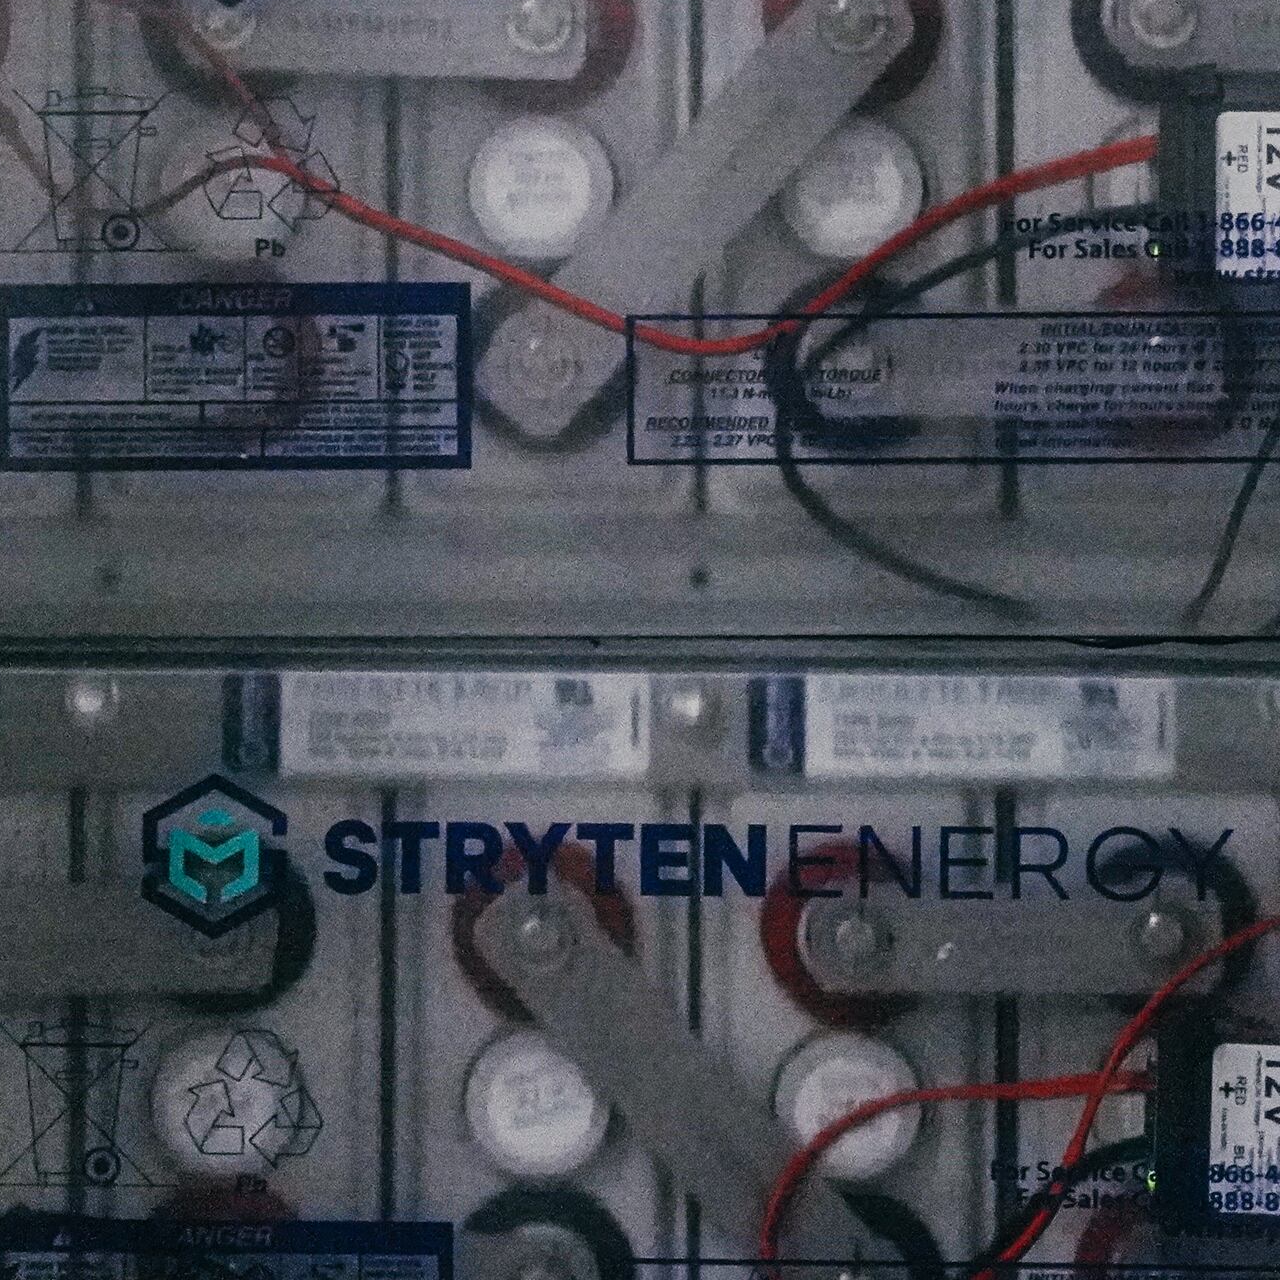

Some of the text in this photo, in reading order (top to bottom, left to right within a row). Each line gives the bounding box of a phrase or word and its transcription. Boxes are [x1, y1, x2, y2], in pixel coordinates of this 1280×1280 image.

[1237, 143, 1249, 174] RED
[255, 237, 286, 257] Pb
[1028, 239, 1068, 259] For
[1074, 238, 1138, 259] Sales
[323, 818, 1234, 902] STRYTEN ENERGY
[1235, 1075, 1248, 1106] RED
[159, 1225, 273, 1248] ANGER
